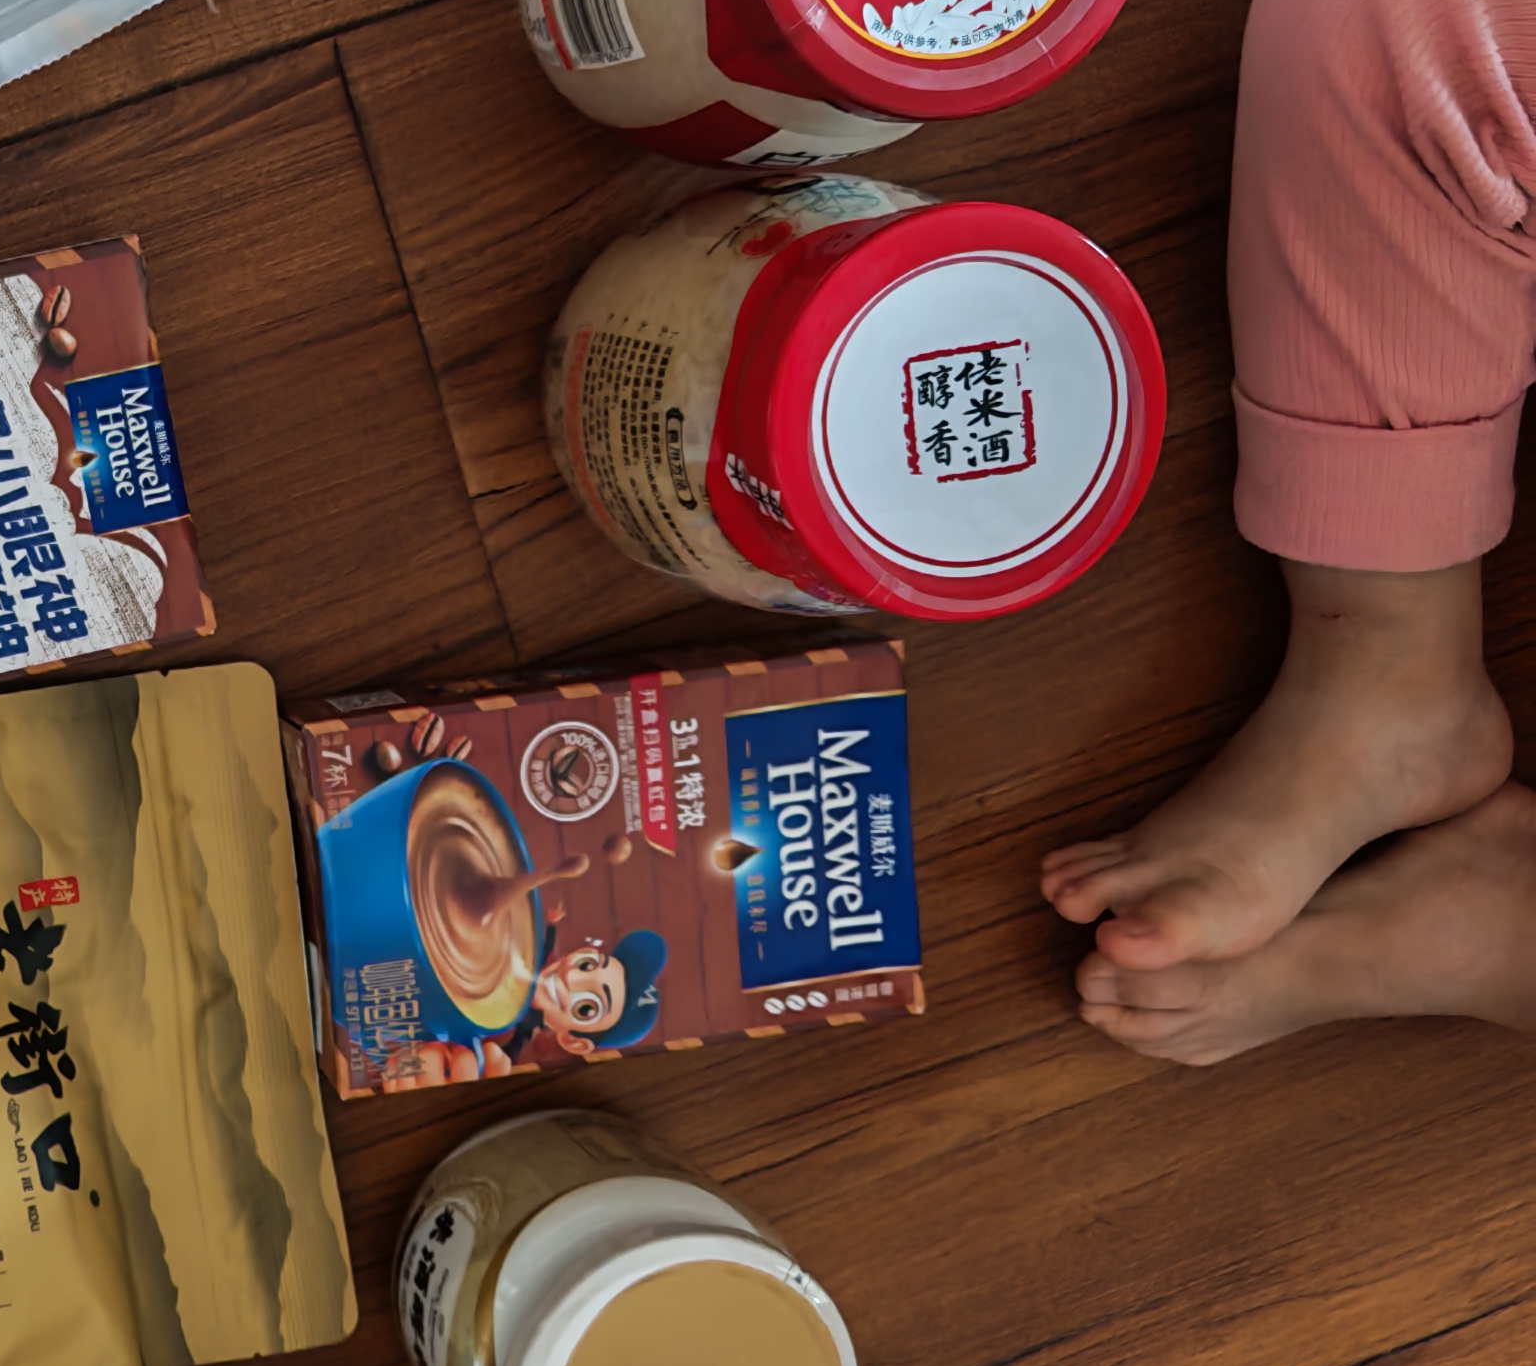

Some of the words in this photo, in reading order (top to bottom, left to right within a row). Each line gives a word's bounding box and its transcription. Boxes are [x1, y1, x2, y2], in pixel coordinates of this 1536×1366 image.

[94, 401, 137, 499] House
[120, 381, 172, 508] Maxwell
[152, 418, 172, 465] 麦斯威尔
[917, 368, 958, 465] 醇香
[953, 350, 1022, 463] 佬米酒
[671, 771, 707, 831] 特浓
[765, 757, 826, 930] House
[816, 724, 885, 950] Maxwell
[867, 791, 897, 877] 麦斯威尔
[18, 874, 77, 912] 特产
[12, 1137, 28, 1163] LAO
[25, 1204, 42, 1232] KOU
